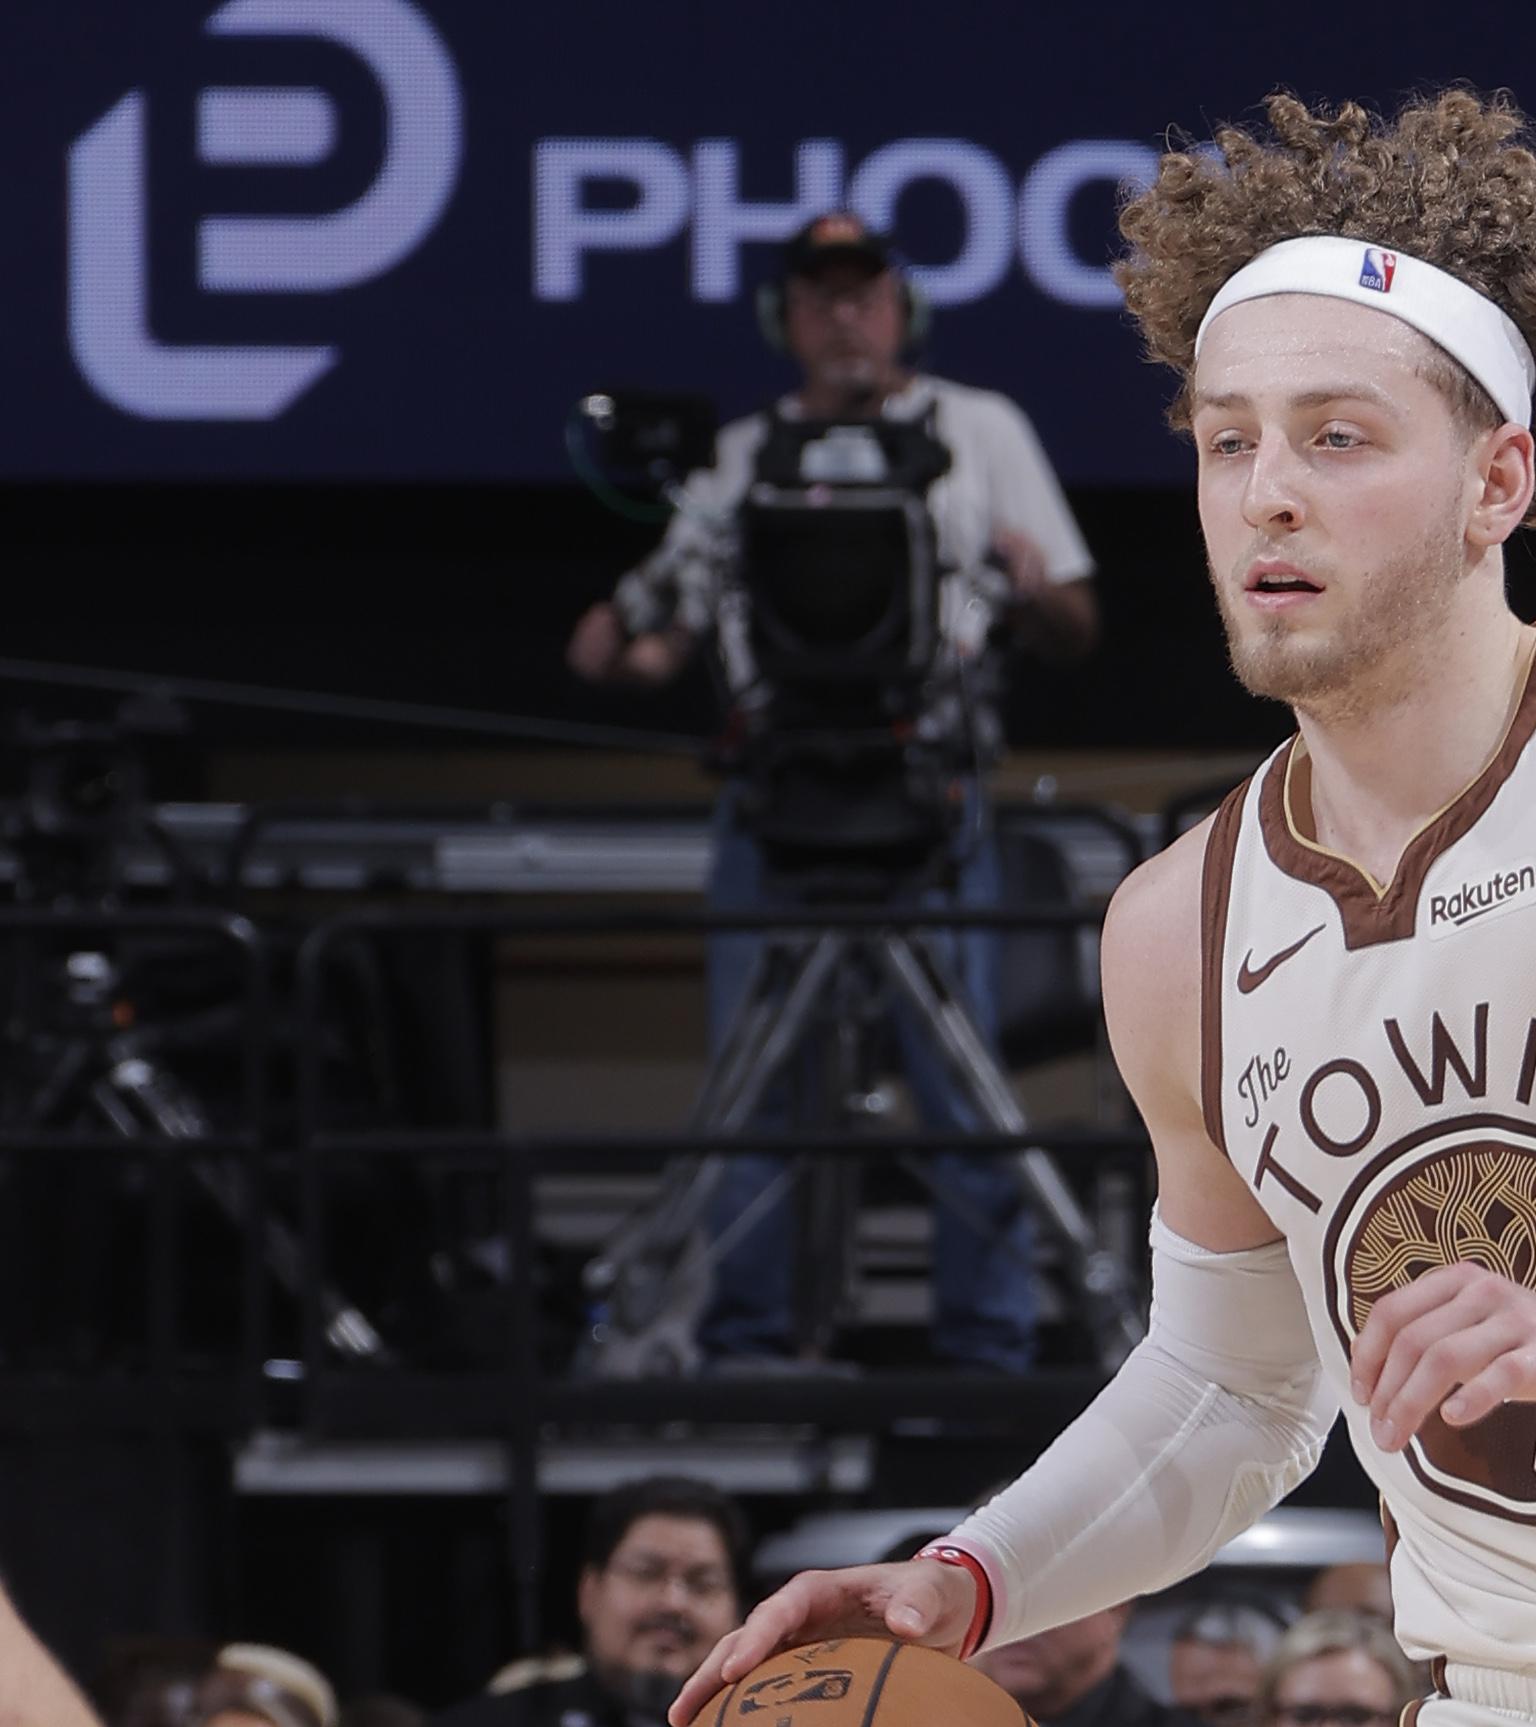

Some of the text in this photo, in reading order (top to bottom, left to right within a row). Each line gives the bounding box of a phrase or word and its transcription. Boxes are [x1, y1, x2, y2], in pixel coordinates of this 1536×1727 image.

[1361, 275, 1382, 289] NBA
[1430, 866, 1535, 926] Rakuten
[1237, 1046, 1291, 1128] The
